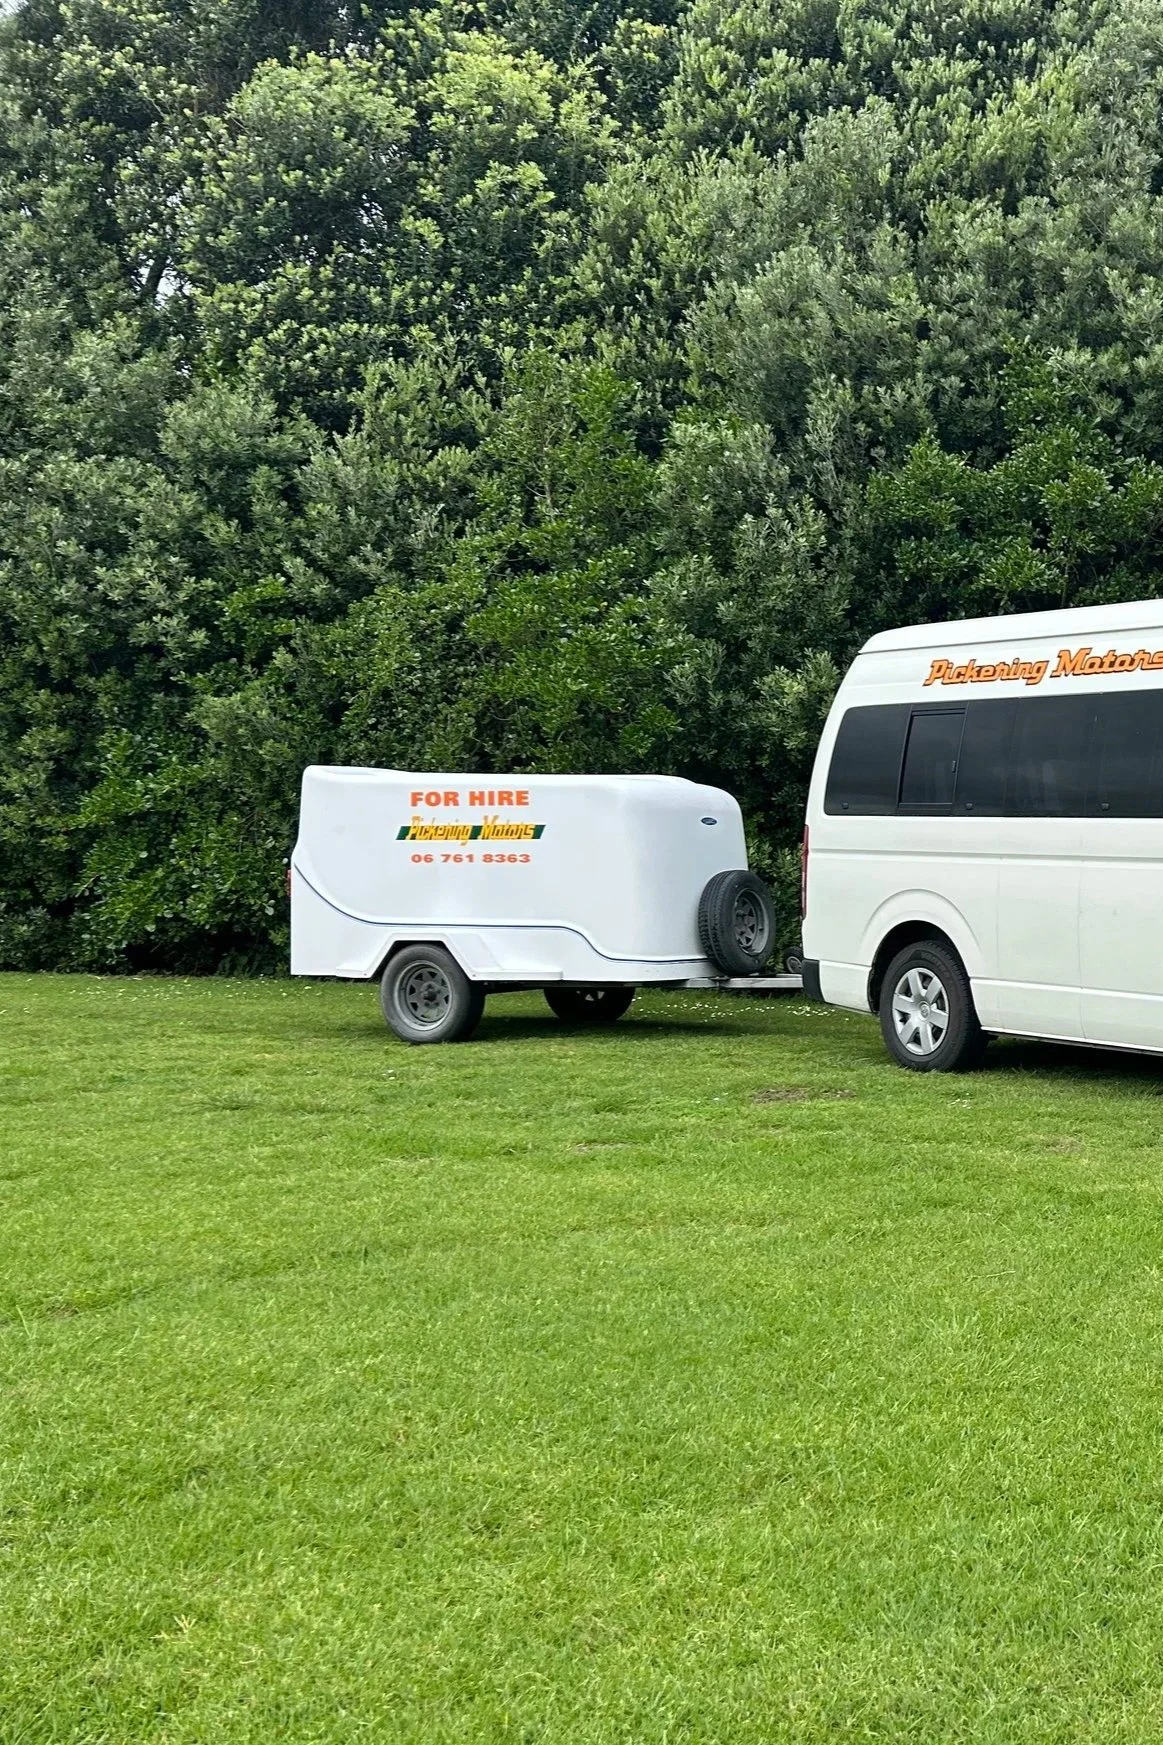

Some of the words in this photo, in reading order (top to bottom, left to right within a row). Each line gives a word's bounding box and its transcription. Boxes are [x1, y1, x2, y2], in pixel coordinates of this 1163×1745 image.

[922, 658, 1050, 686] Pickering
[410, 791, 460, 807] FOR
[468, 790, 530, 806] HIRE
[405, 815, 473, 847] Pickering
[477, 814, 536, 841] Motors
[411, 853, 434, 863] 06
[440, 853, 474, 863] 761
[482, 853, 531, 863] 8363
